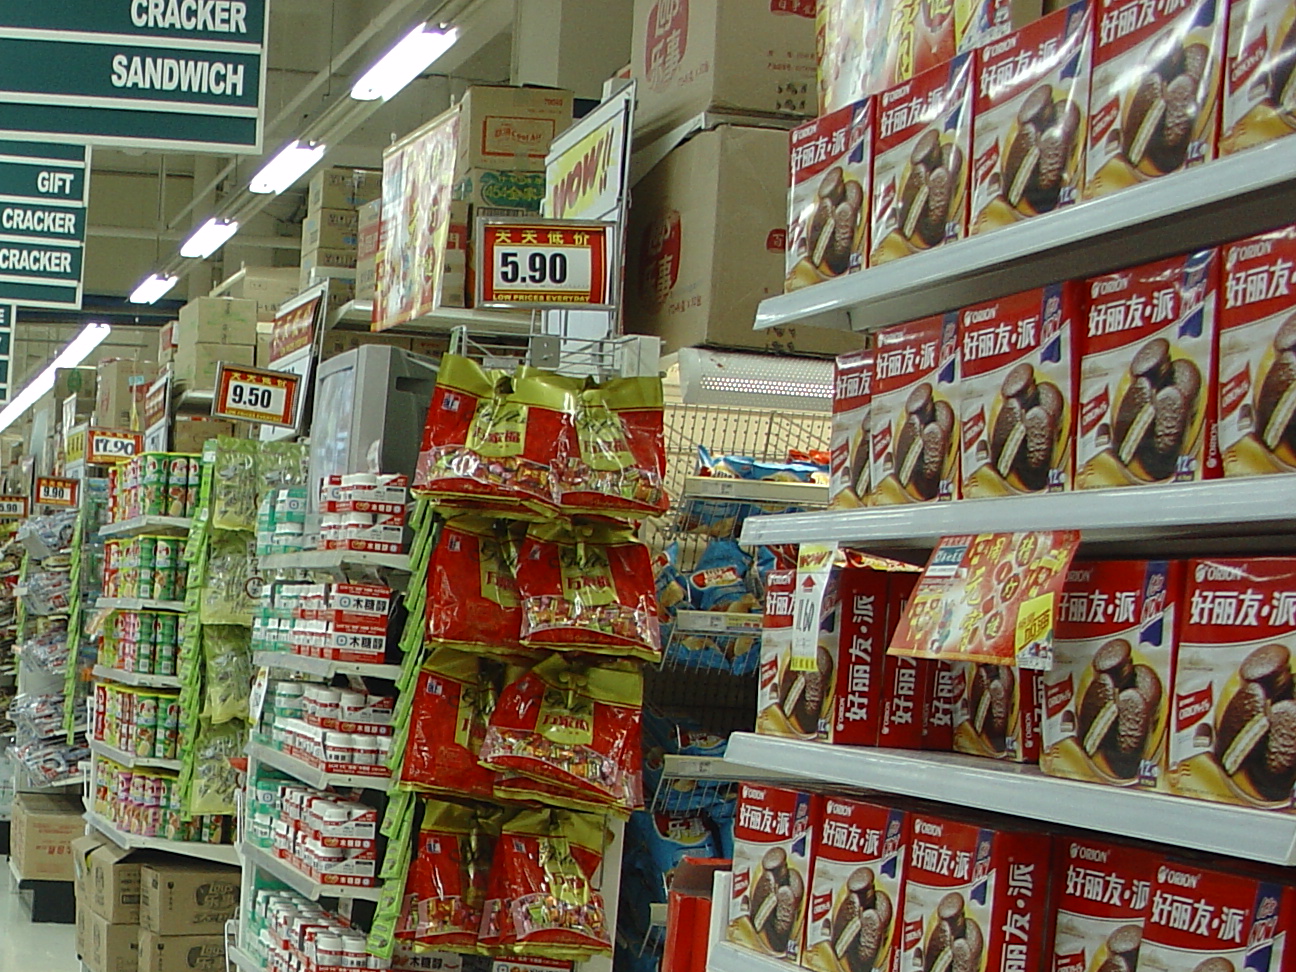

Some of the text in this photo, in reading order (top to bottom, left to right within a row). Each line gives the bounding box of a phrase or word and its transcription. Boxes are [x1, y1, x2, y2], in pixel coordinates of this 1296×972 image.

[130, 0, 247, 33] CRACKER
[111, 54, 244, 96] SANDWICH
[980, 38, 1057, 97] 好丽友·派
[880, 85, 946, 138] 好丽友·派
[791, 131, 845, 169] 好丽友·派
[37, 171, 74, 195] GIFT
[3, 208, 75, 234] CRACKER
[495, 230, 590, 246] 天天低价
[1239, 241, 1272, 260] ORION
[500, 252, 568, 285] 5.90
[493, 293, 590, 303] LOW PRICES EVERYDAY
[1088, 290, 1174, 337] 好丽友·派
[963, 319, 1036, 362] 好丽友·派
[876, 342, 935, 379] 好丽友·派
[231, 385, 272, 409] 9.50
[43, 488, 65, 498] 9.90
[1206, 565, 1244, 582] ORION
[352, 598, 387, 612] 木糖醇
[350, 636, 383, 649] 木糖醇
[740, 808, 790, 835] 好丽友·派
[1168, 871, 1200, 889] ORION
[1152, 891, 1245, 943] 好丽友·派
[410, 956, 442, 970] 木糖醇
